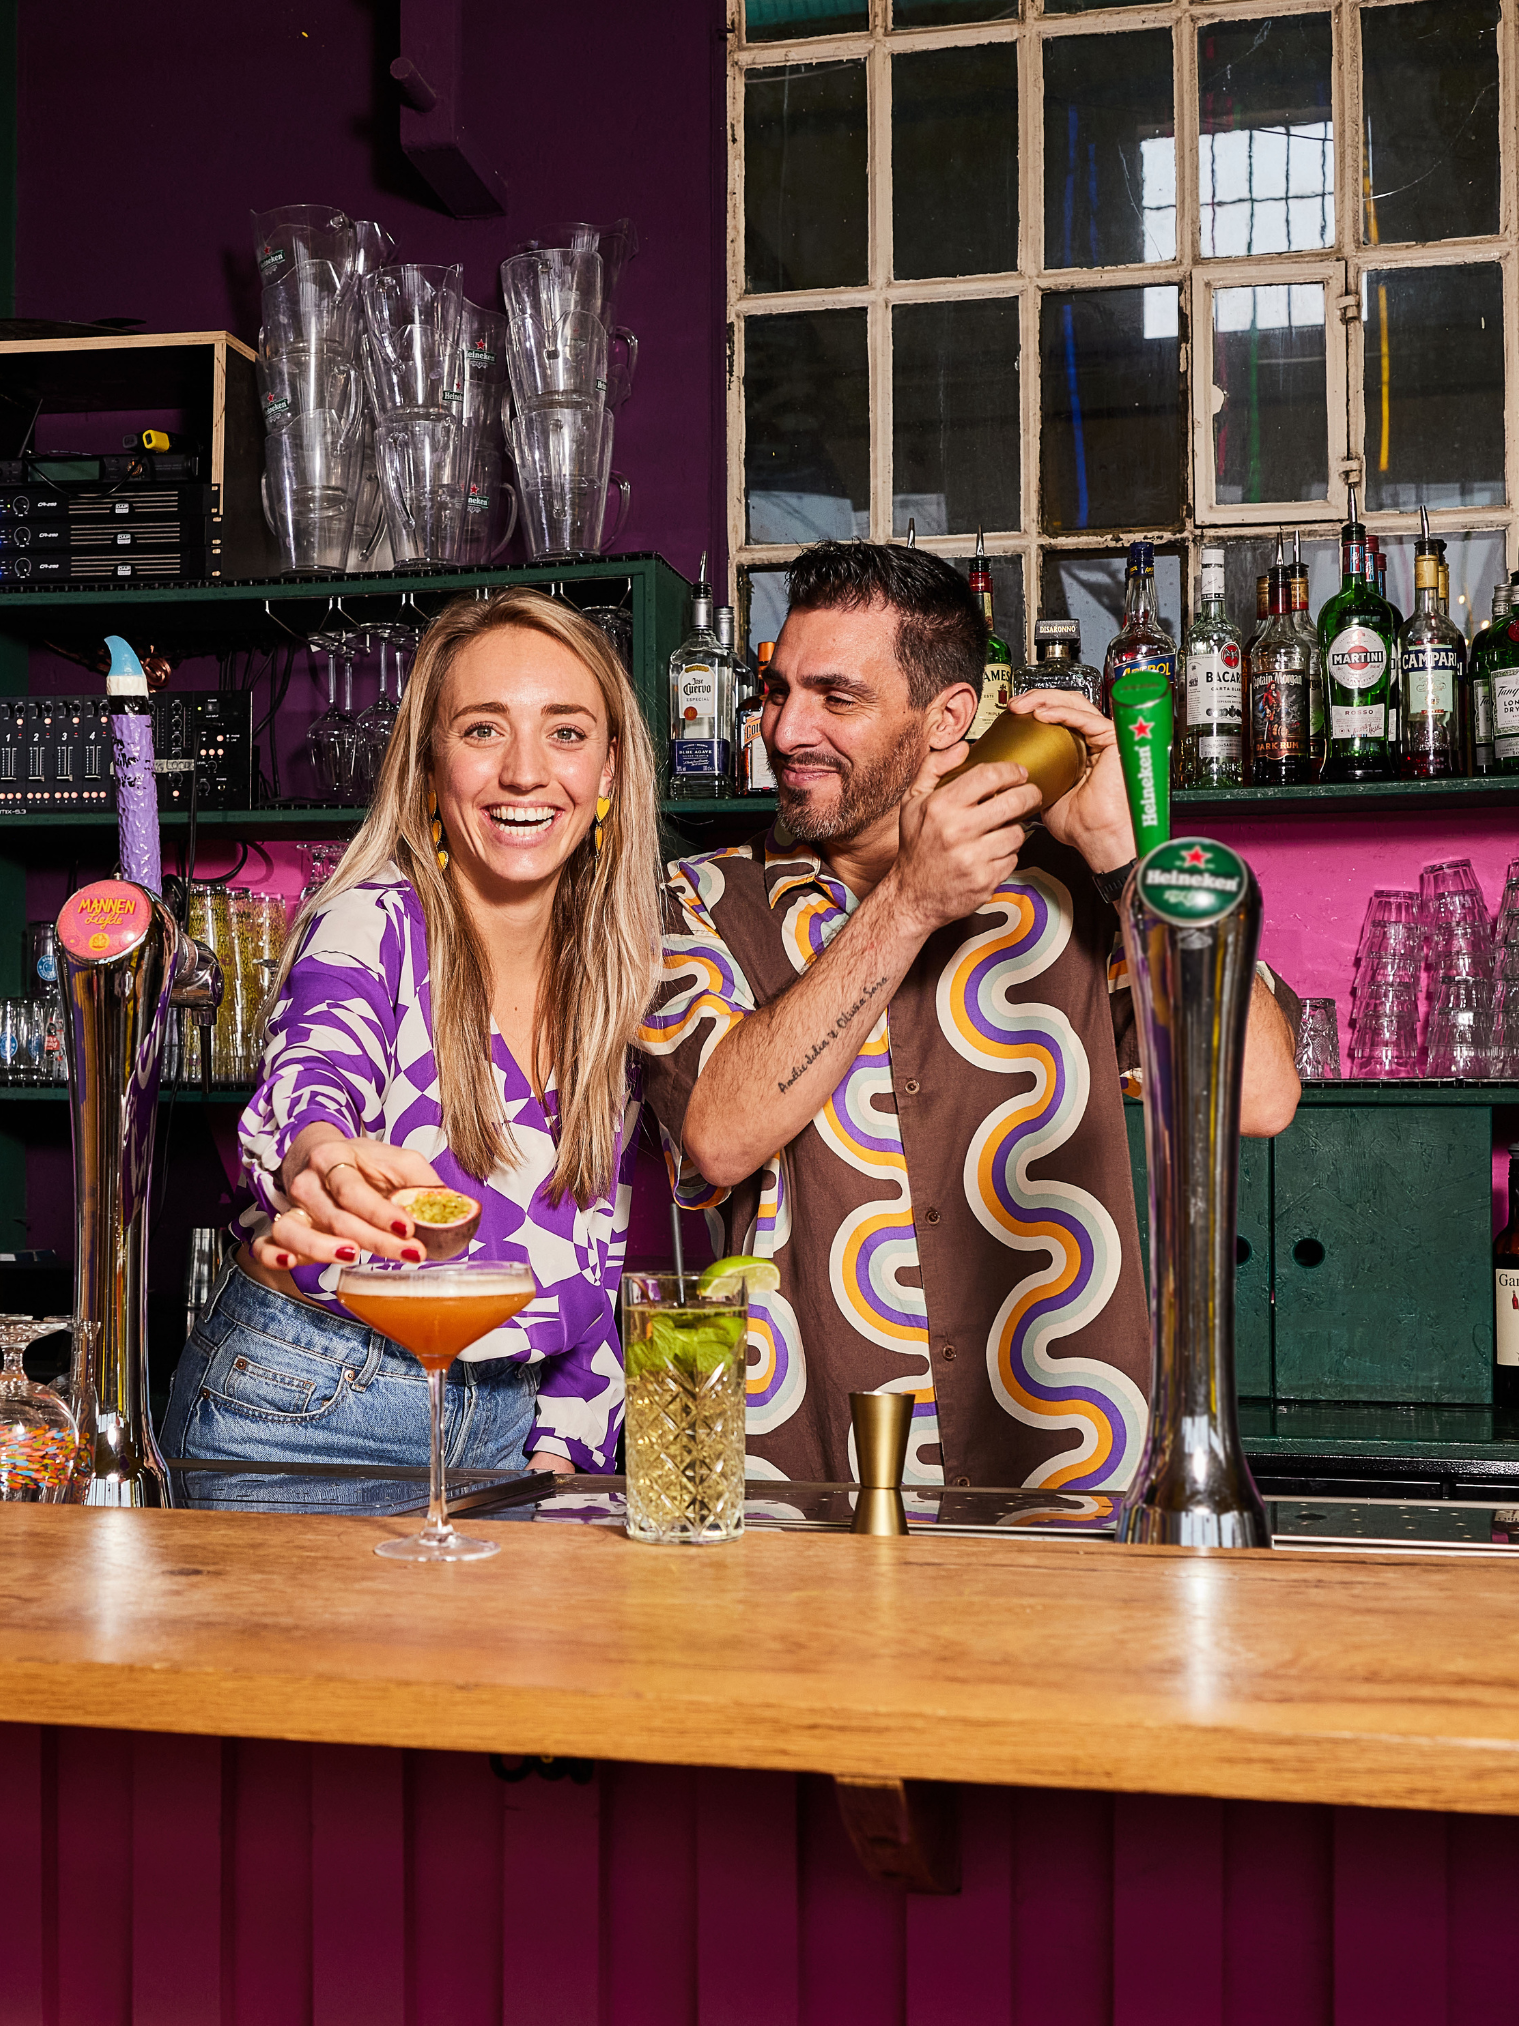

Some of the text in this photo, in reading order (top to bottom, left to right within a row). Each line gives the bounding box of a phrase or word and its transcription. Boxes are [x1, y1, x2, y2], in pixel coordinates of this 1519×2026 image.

[466, 350, 494, 361] eineken
[467, 496, 488, 506] neken
[1040, 625, 1076, 633] DISARONNO
[1333, 652, 1382, 664] MARTINI
[1402, 651, 1457, 669] CAMPARI
[983, 669, 1010, 682] AMES
[682, 682, 711, 696] Cuervo
[5, 731, 96, 742] 1 2 3 4
[1280, 741, 1299, 749] RUM
[1135, 745, 1158, 827] Heineken
[1145, 869, 1240, 893] Heineken
[77, 898, 136, 915] MANNEN
[85, 910, 123, 930] Liefde
